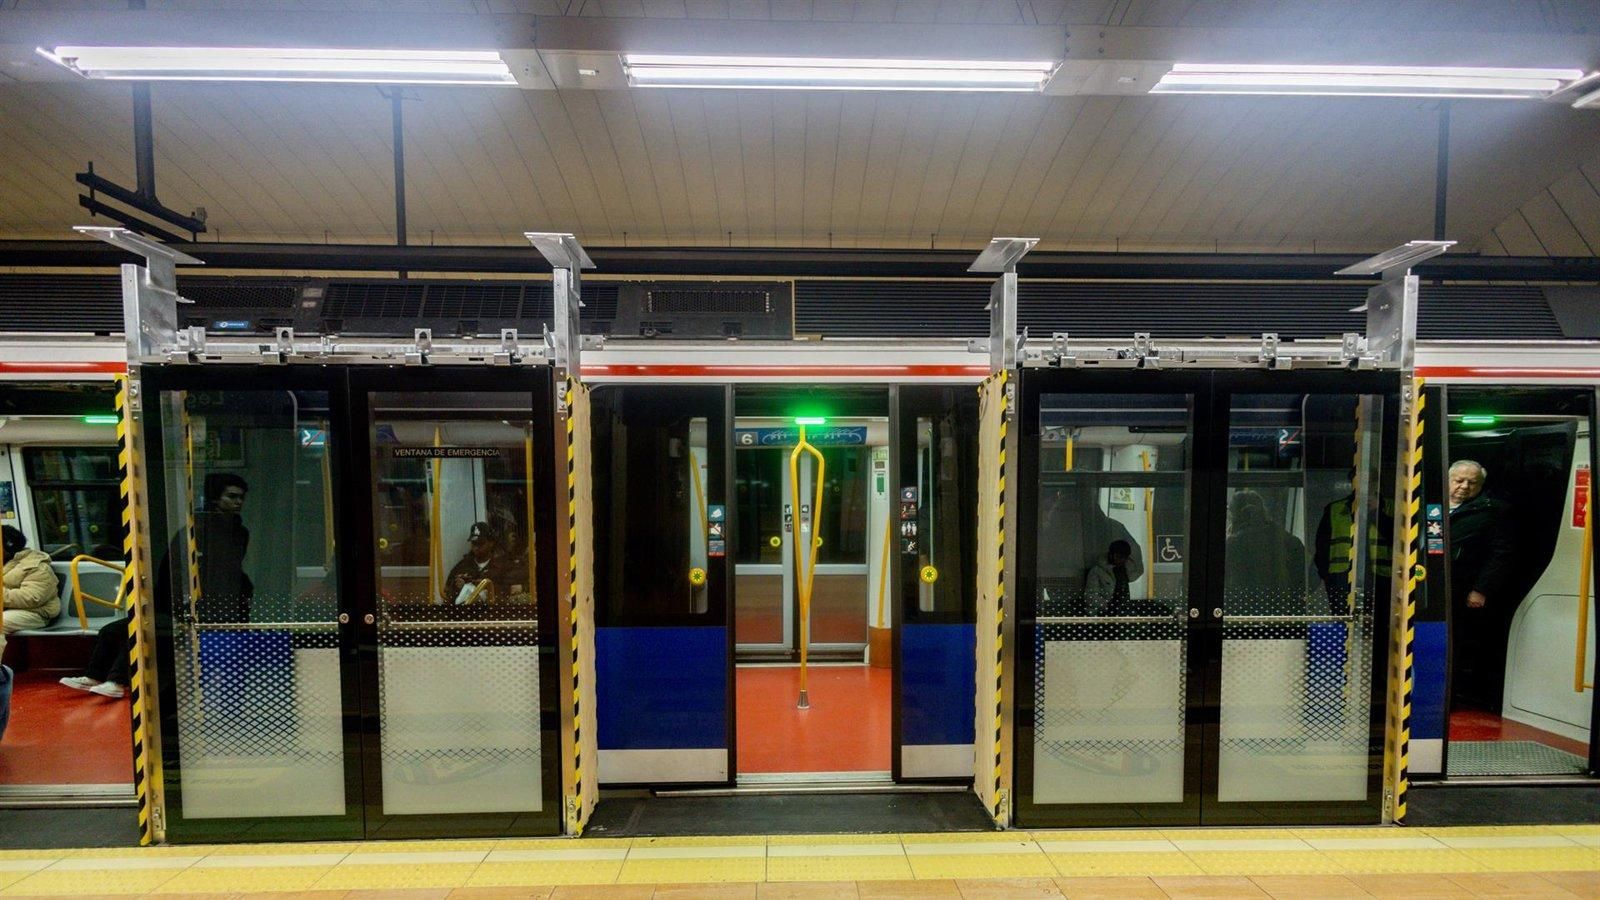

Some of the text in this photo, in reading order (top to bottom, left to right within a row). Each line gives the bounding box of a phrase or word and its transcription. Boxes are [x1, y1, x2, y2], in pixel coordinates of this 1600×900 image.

[741, 434, 753, 445] 6
[394, 448, 500, 457] VENTANA DE EMERGENCIA
